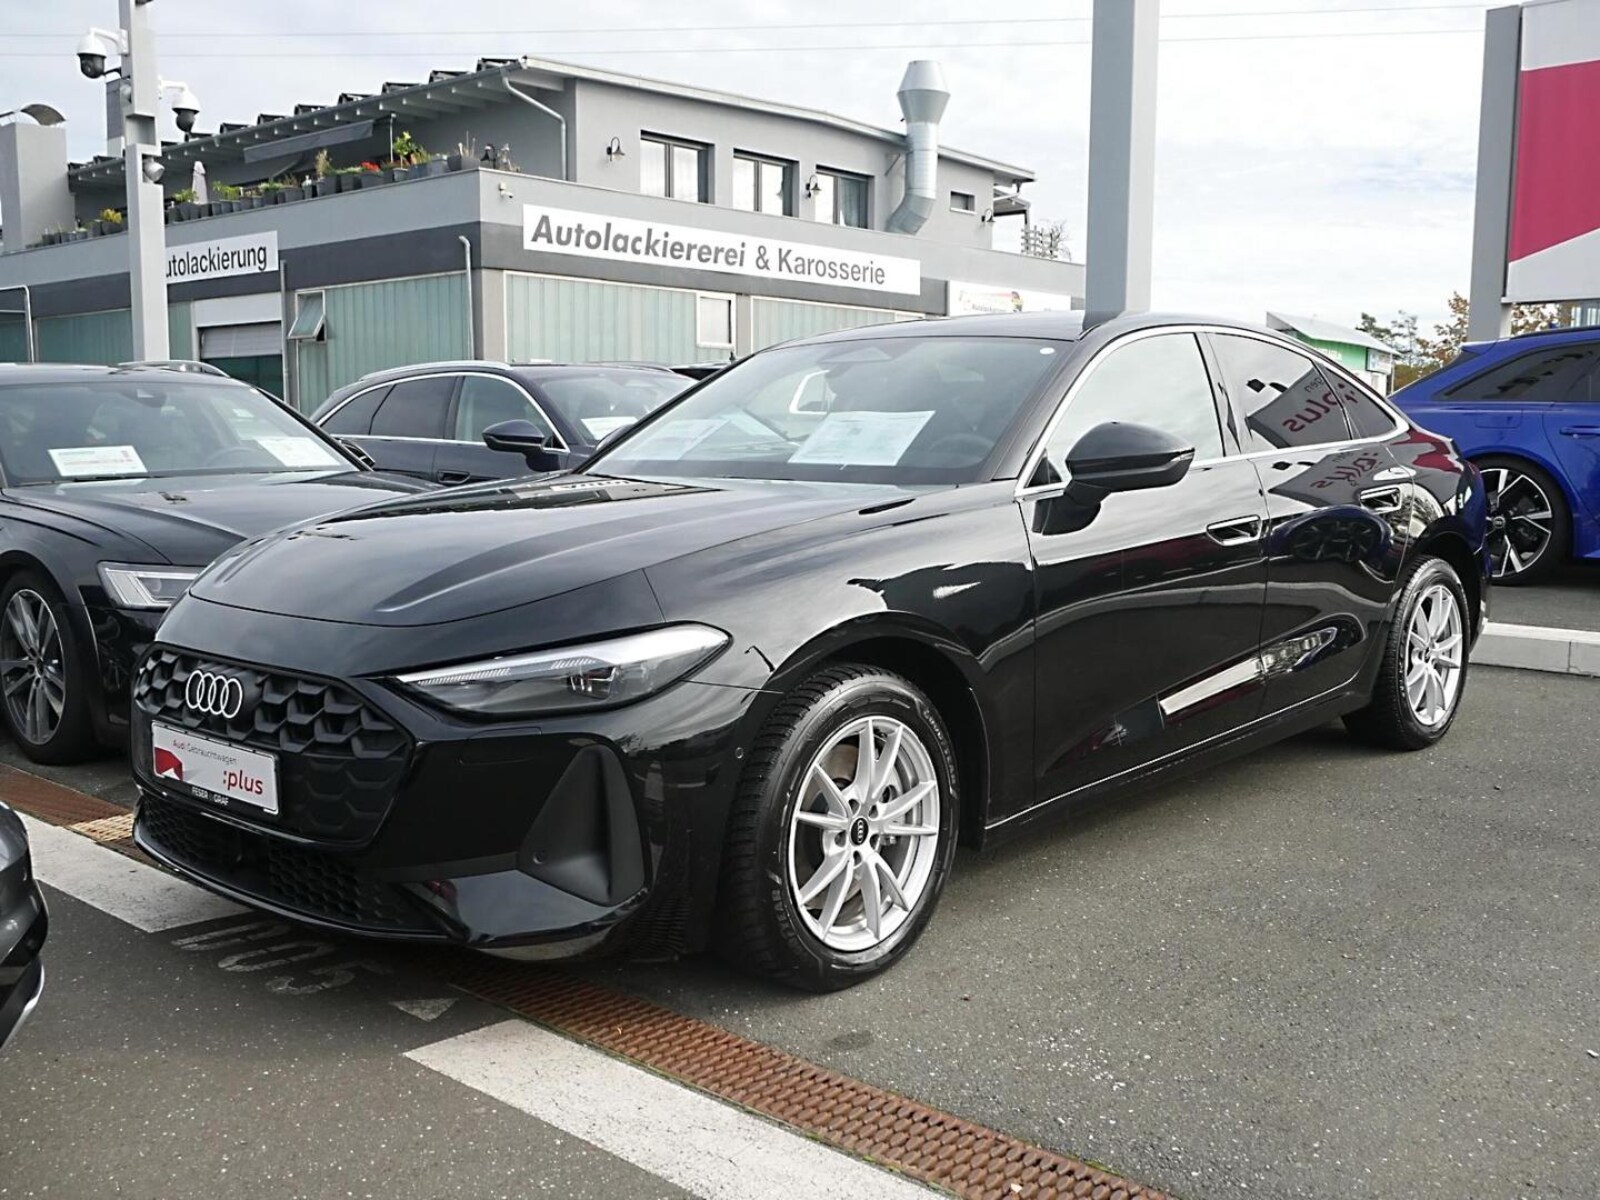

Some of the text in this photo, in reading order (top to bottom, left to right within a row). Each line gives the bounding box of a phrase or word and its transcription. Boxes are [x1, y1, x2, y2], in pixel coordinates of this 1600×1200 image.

[166, 246, 267, 278] utolackierung
[531, 214, 886, 285] Autolackiererei & Karosserie
[223, 769, 263, 795] :plus
